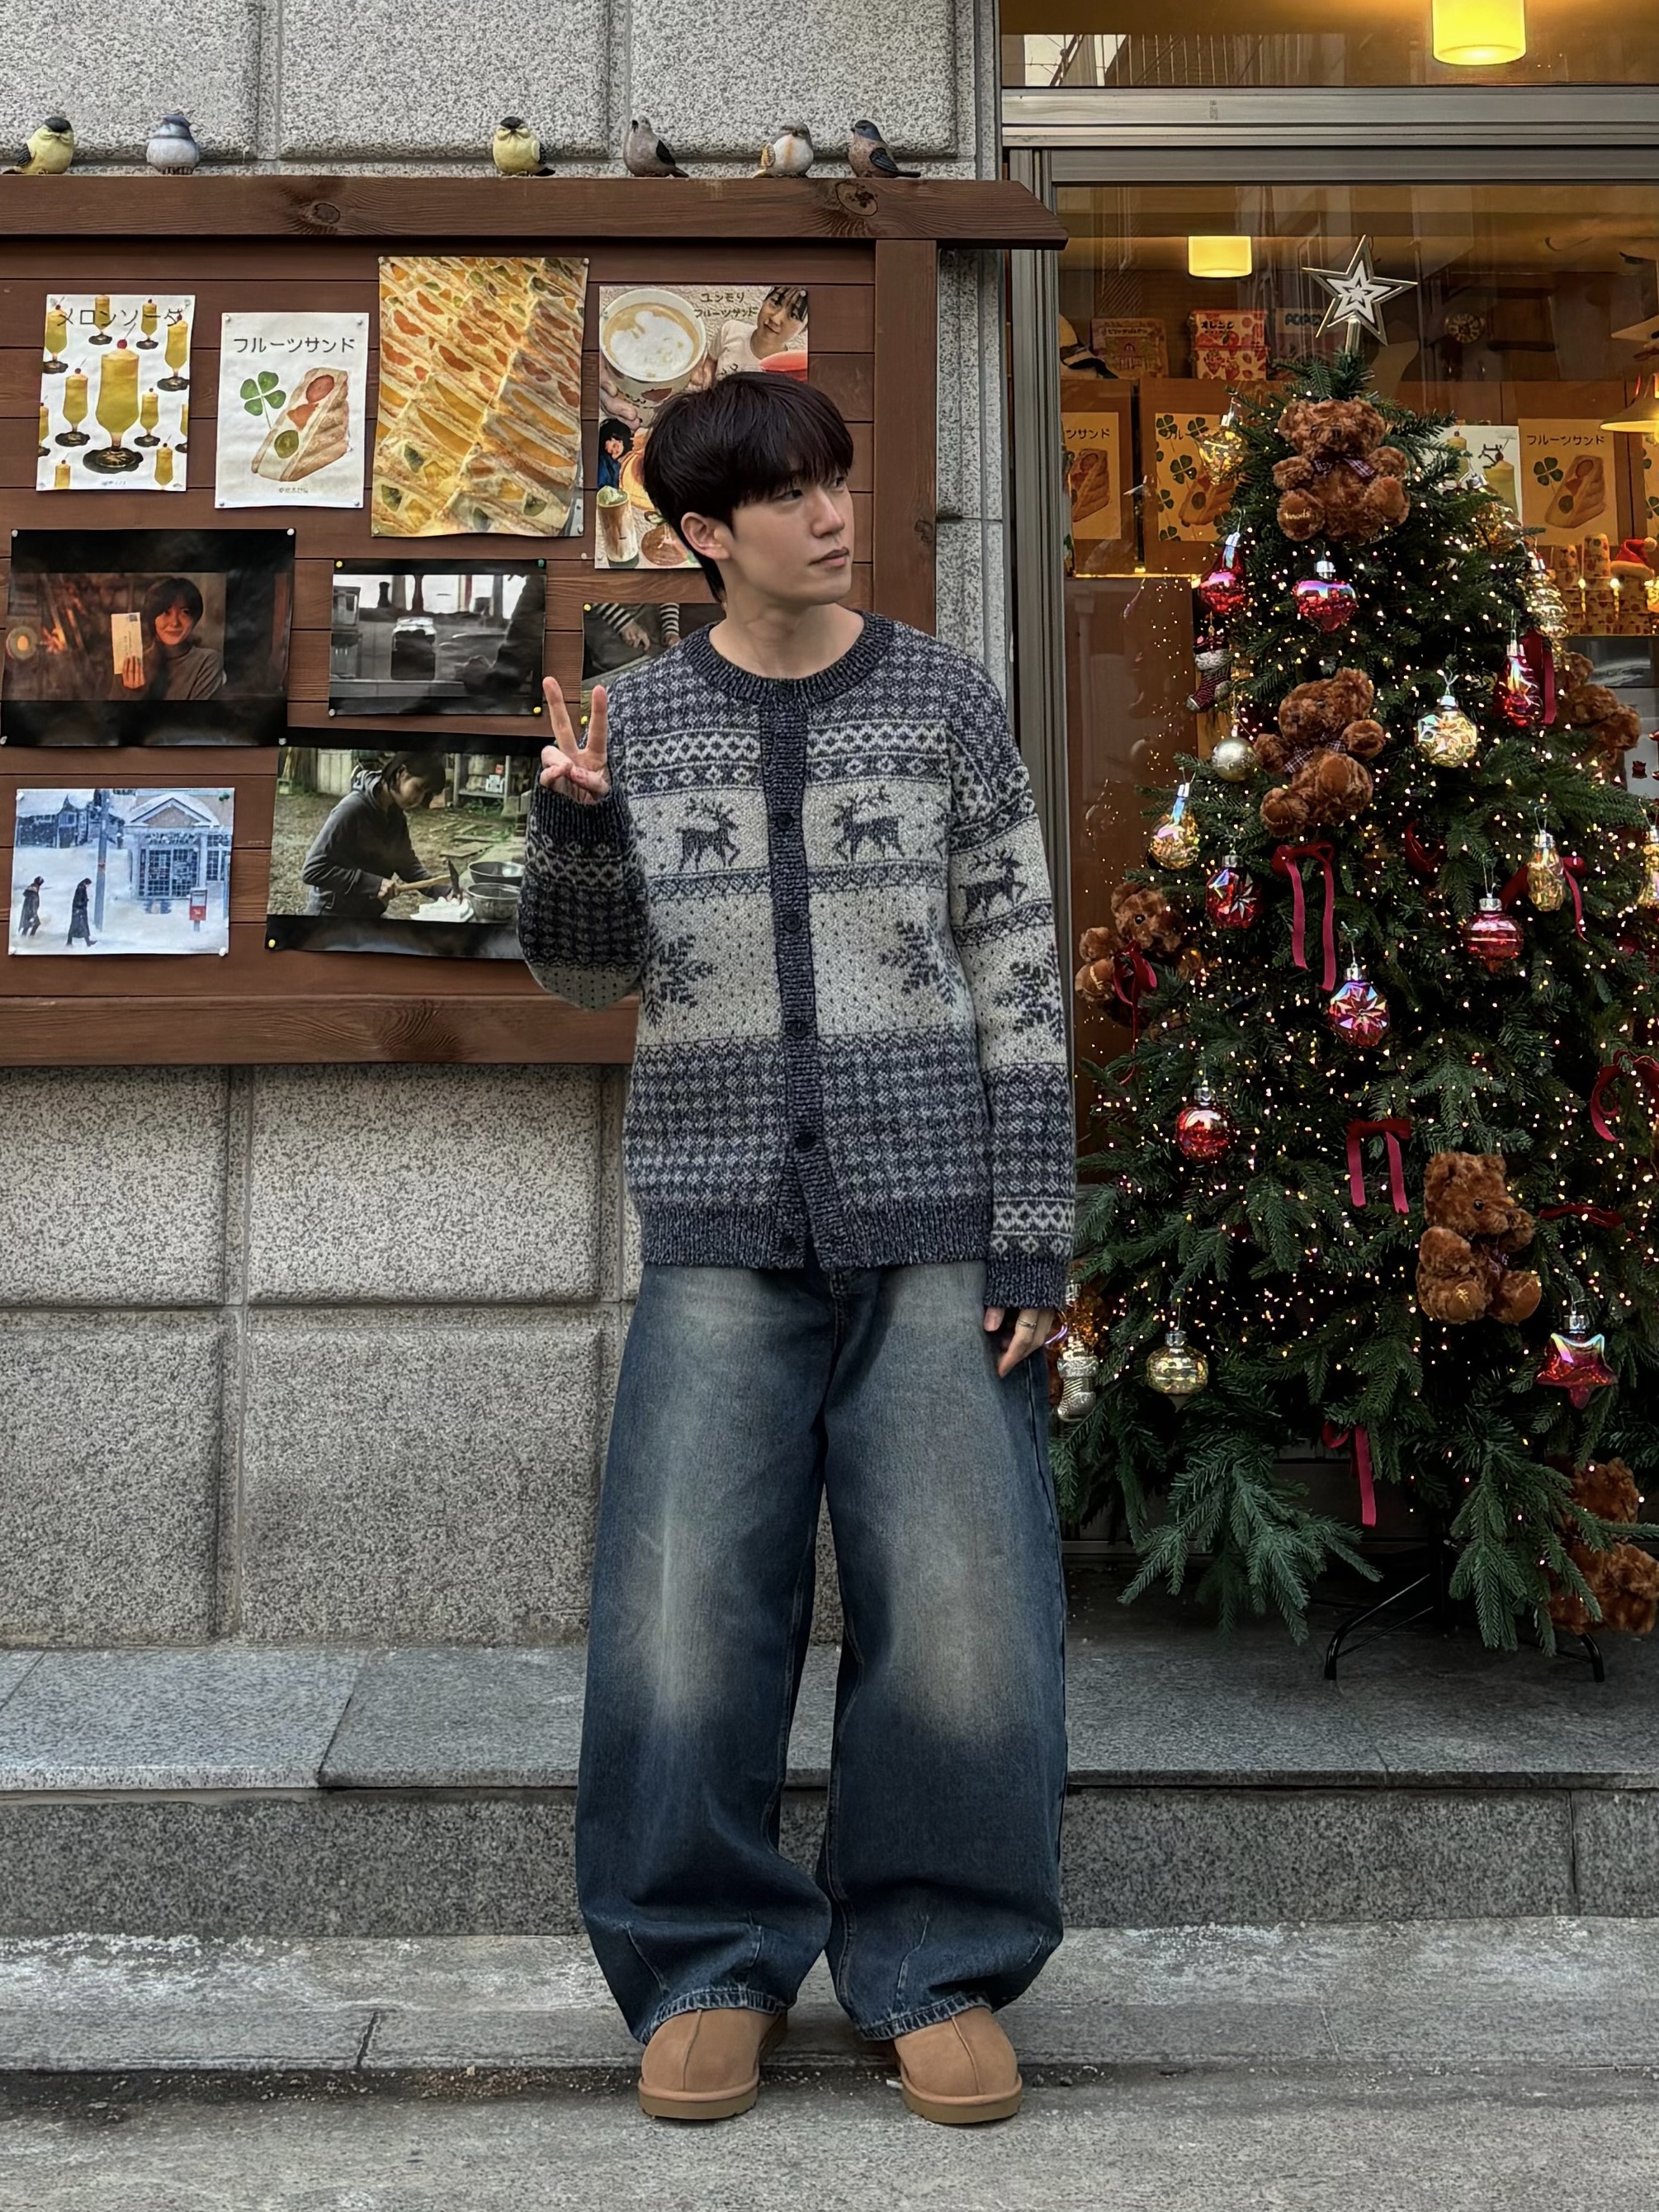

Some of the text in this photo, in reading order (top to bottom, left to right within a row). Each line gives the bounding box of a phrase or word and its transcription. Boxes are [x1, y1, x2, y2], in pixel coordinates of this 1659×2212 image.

[56, 308, 182, 327] メロンソーダ
[693, 306, 759, 318] フルーツサンド
[233, 337, 355, 352] フルーツサンド
